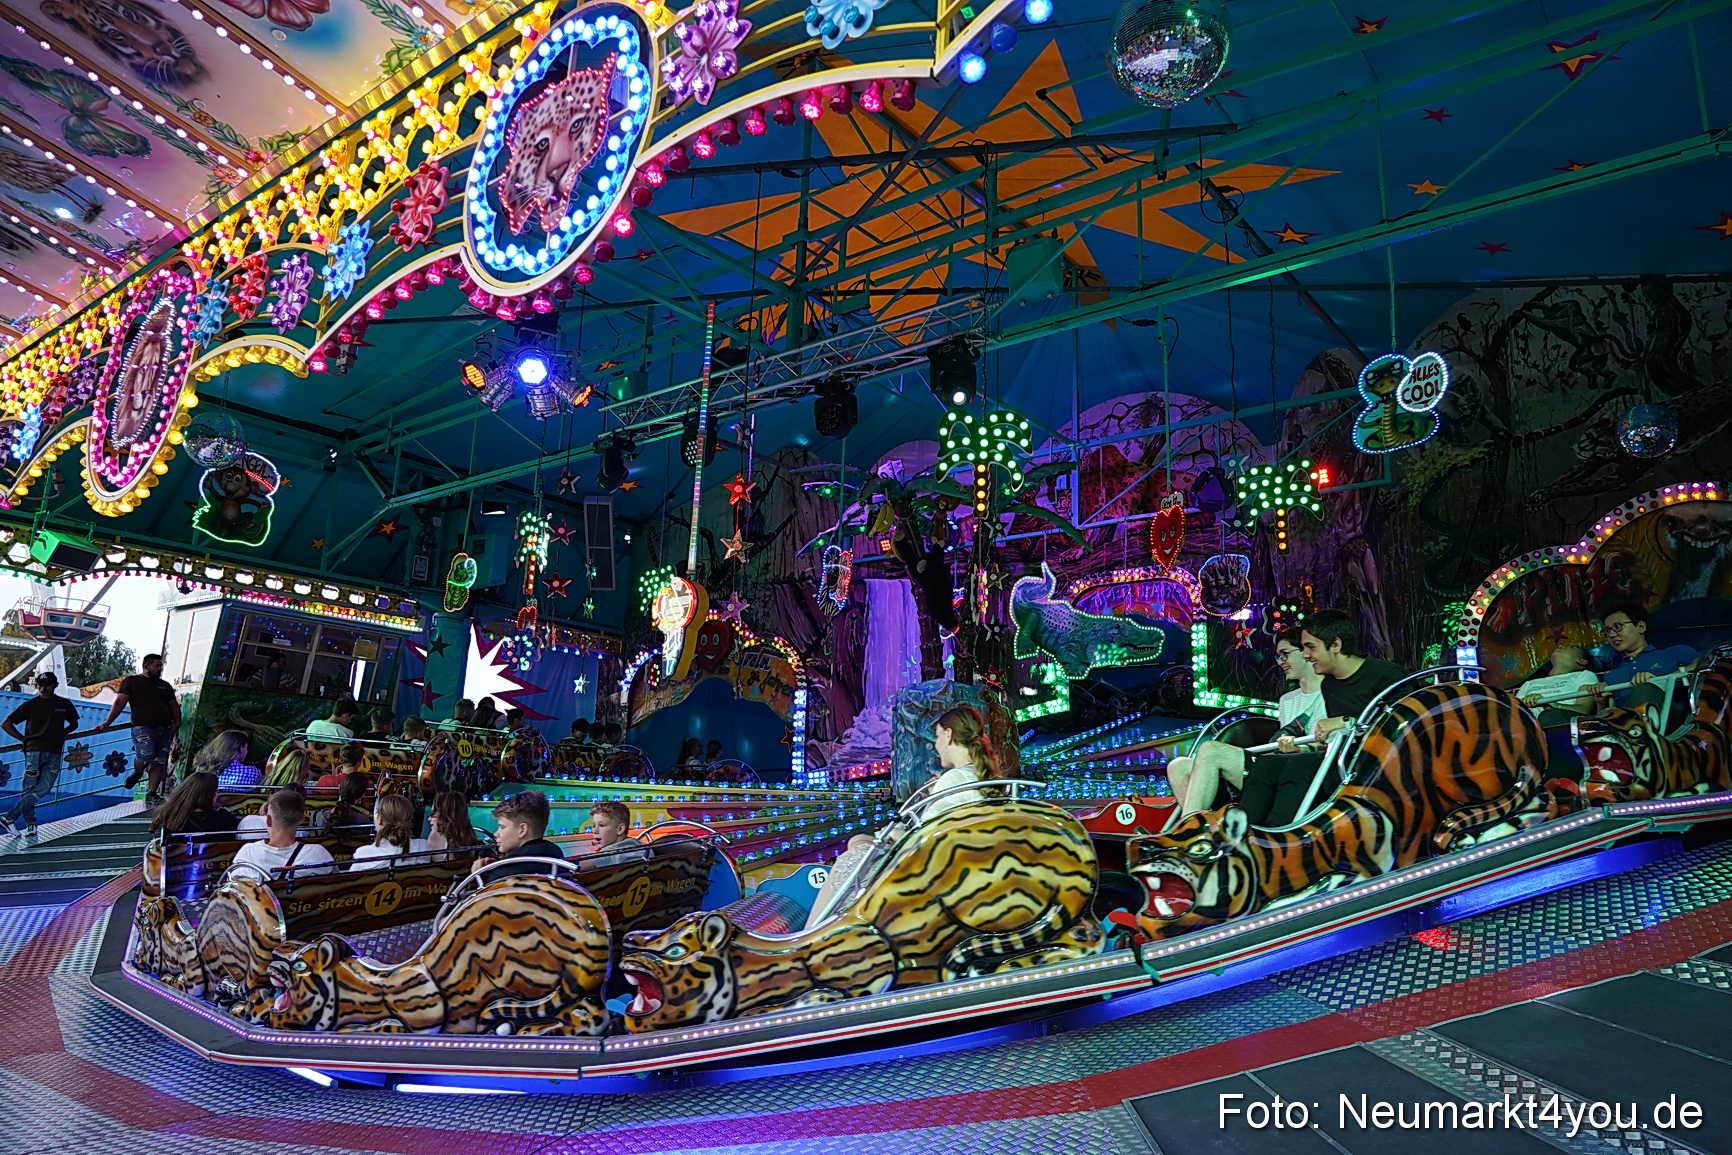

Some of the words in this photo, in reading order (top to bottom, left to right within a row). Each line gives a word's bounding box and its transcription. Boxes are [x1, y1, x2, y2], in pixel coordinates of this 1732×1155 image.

[1408, 363, 1441, 384] ALLES
[1401, 380, 1441, 404] COOL
[460, 744, 471, 754] 10
[371, 760, 383, 768] im
[384, 760, 413, 771] Wagen
[238, 806, 259, 815] sitz
[1118, 808, 1133, 820] 16
[810, 871, 826, 884] 15
[629, 884, 648, 906] 15
[666, 876, 697, 893] Wagen
[288, 900, 312, 915] Sie
[317, 896, 363, 911] sitzen
[371, 888, 396, 907] 14
[403, 887, 421, 899] im
